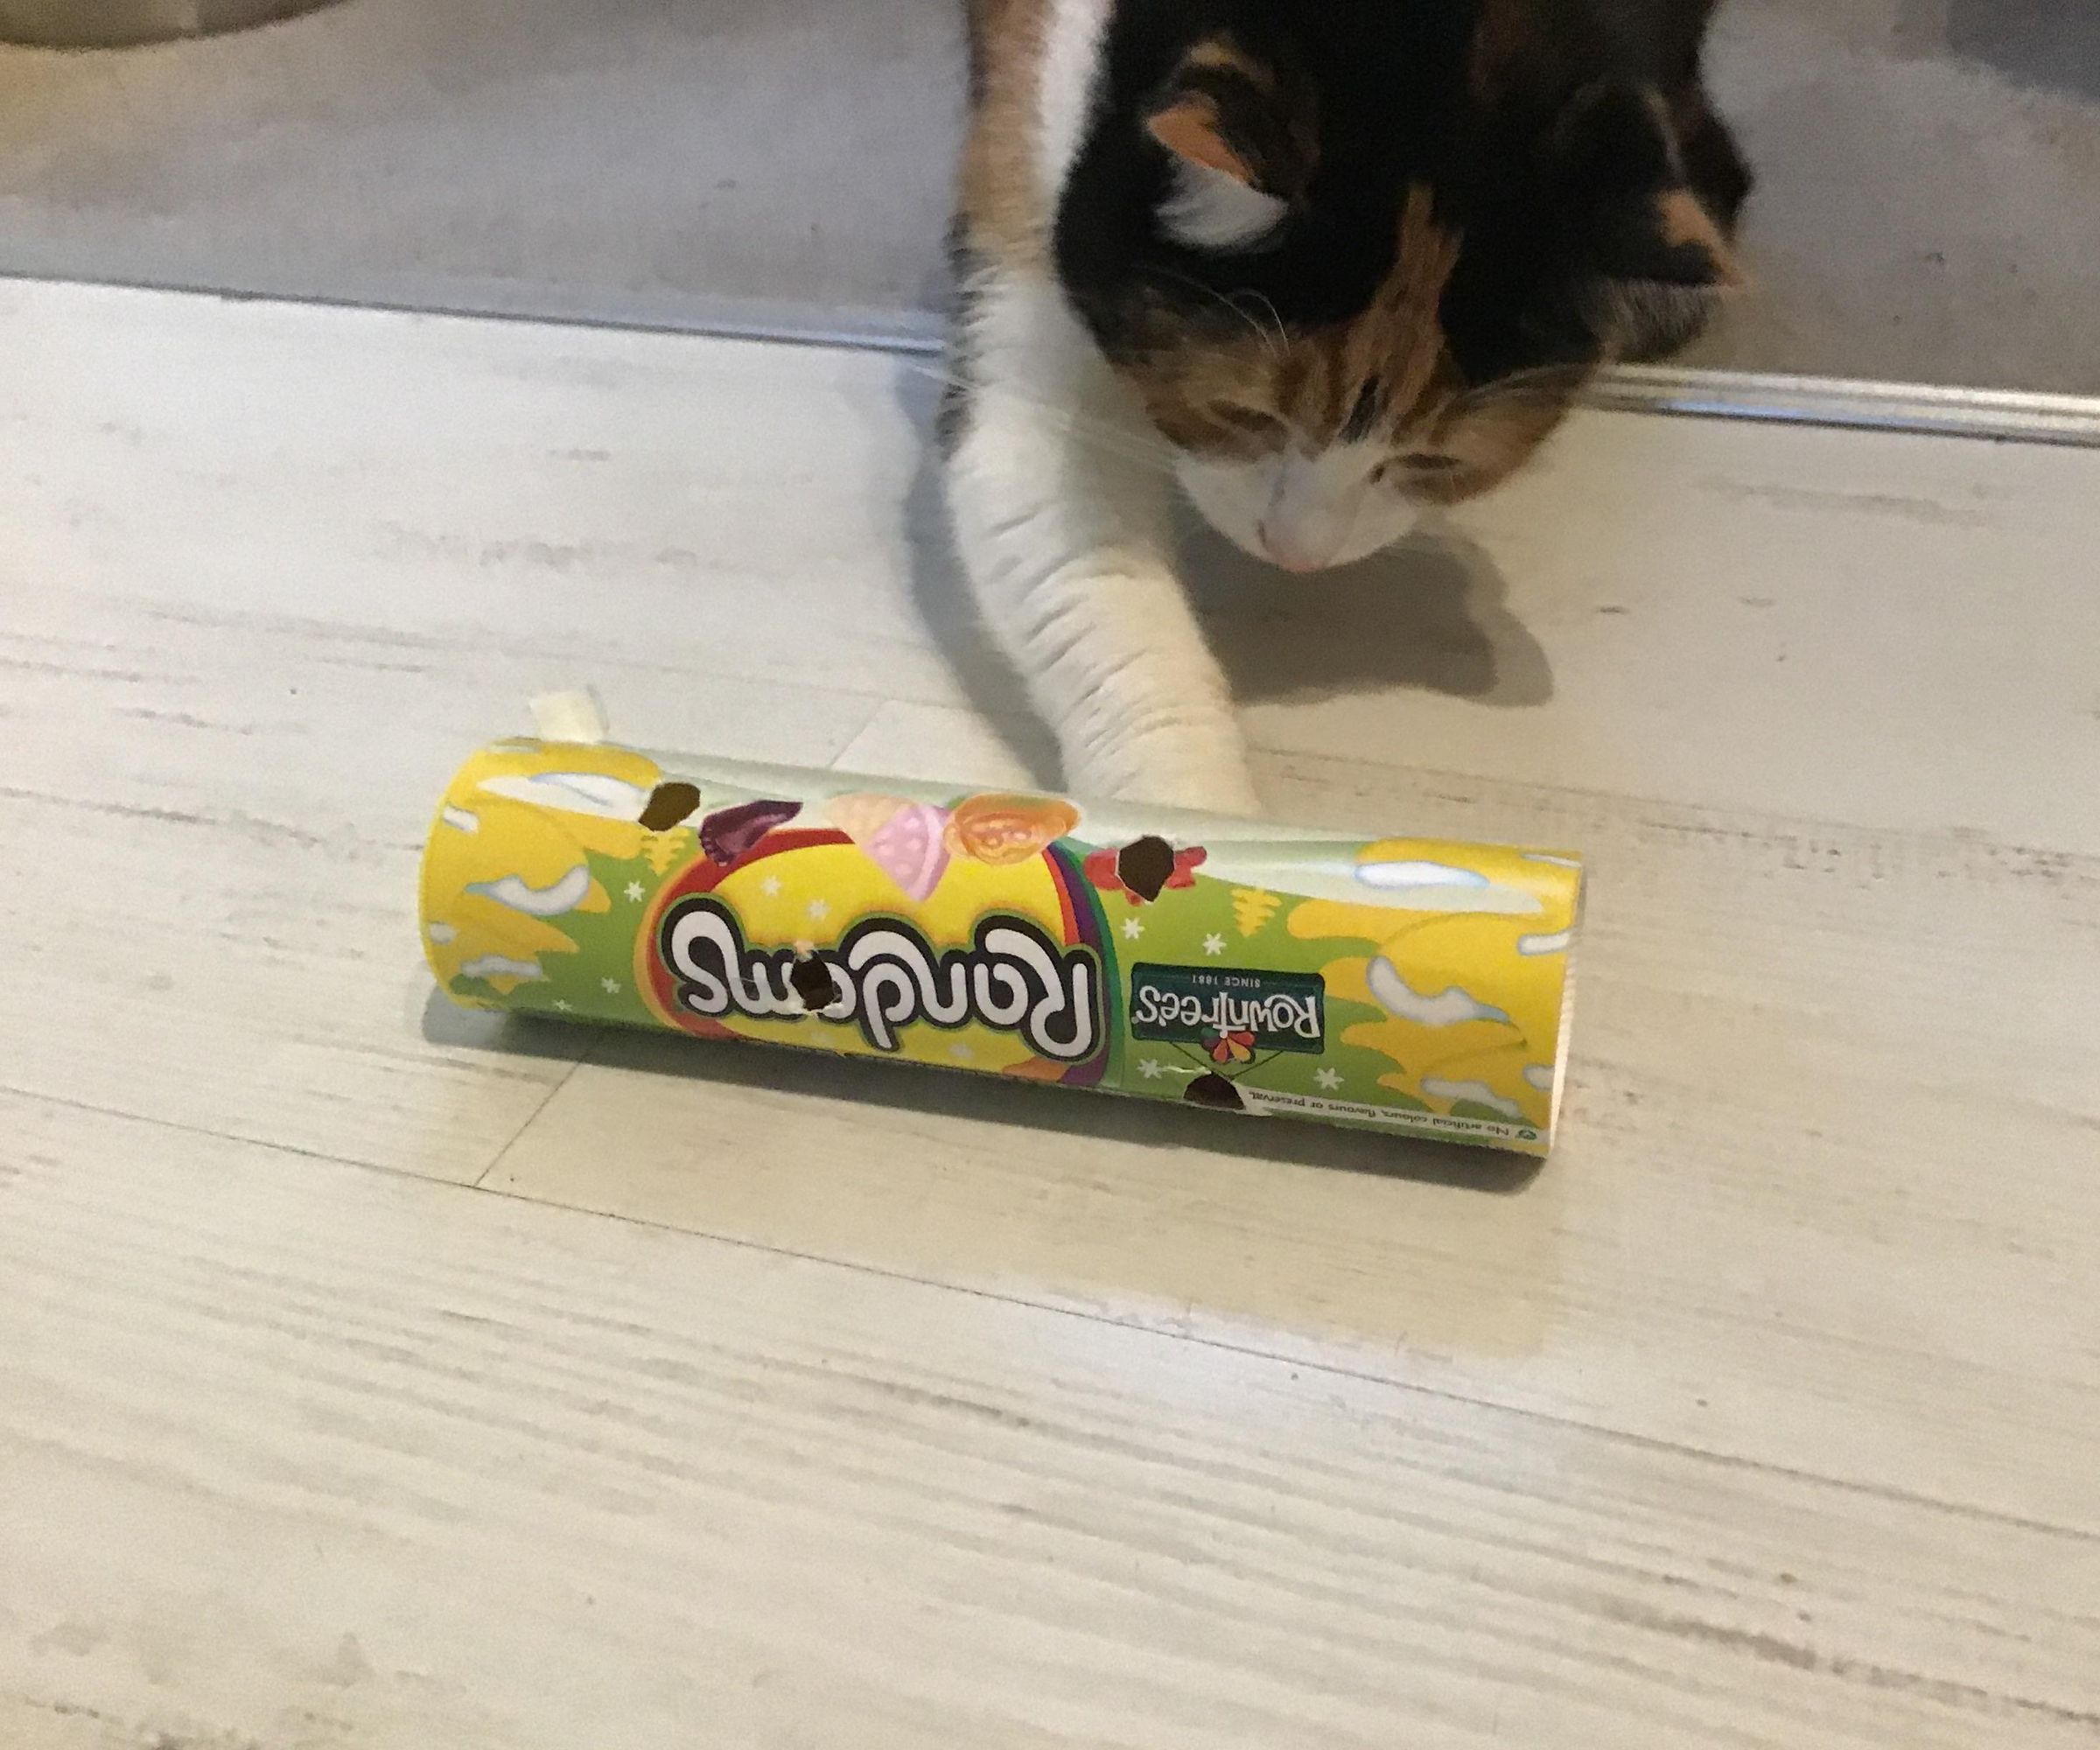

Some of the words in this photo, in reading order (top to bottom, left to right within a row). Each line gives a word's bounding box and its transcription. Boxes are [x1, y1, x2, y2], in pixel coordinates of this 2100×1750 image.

[1192, 974, 1218, 987] 1881
[1224, 976, 1261, 989] SINCE
[1309, 1101, 1324, 1110] or
[1327, 1103, 1376, 1118] flavours
[1382, 1110, 1428, 1124] colours,
[1432, 1117, 1482, 1130] artificial
[1487, 1125, 1509, 1136] No
